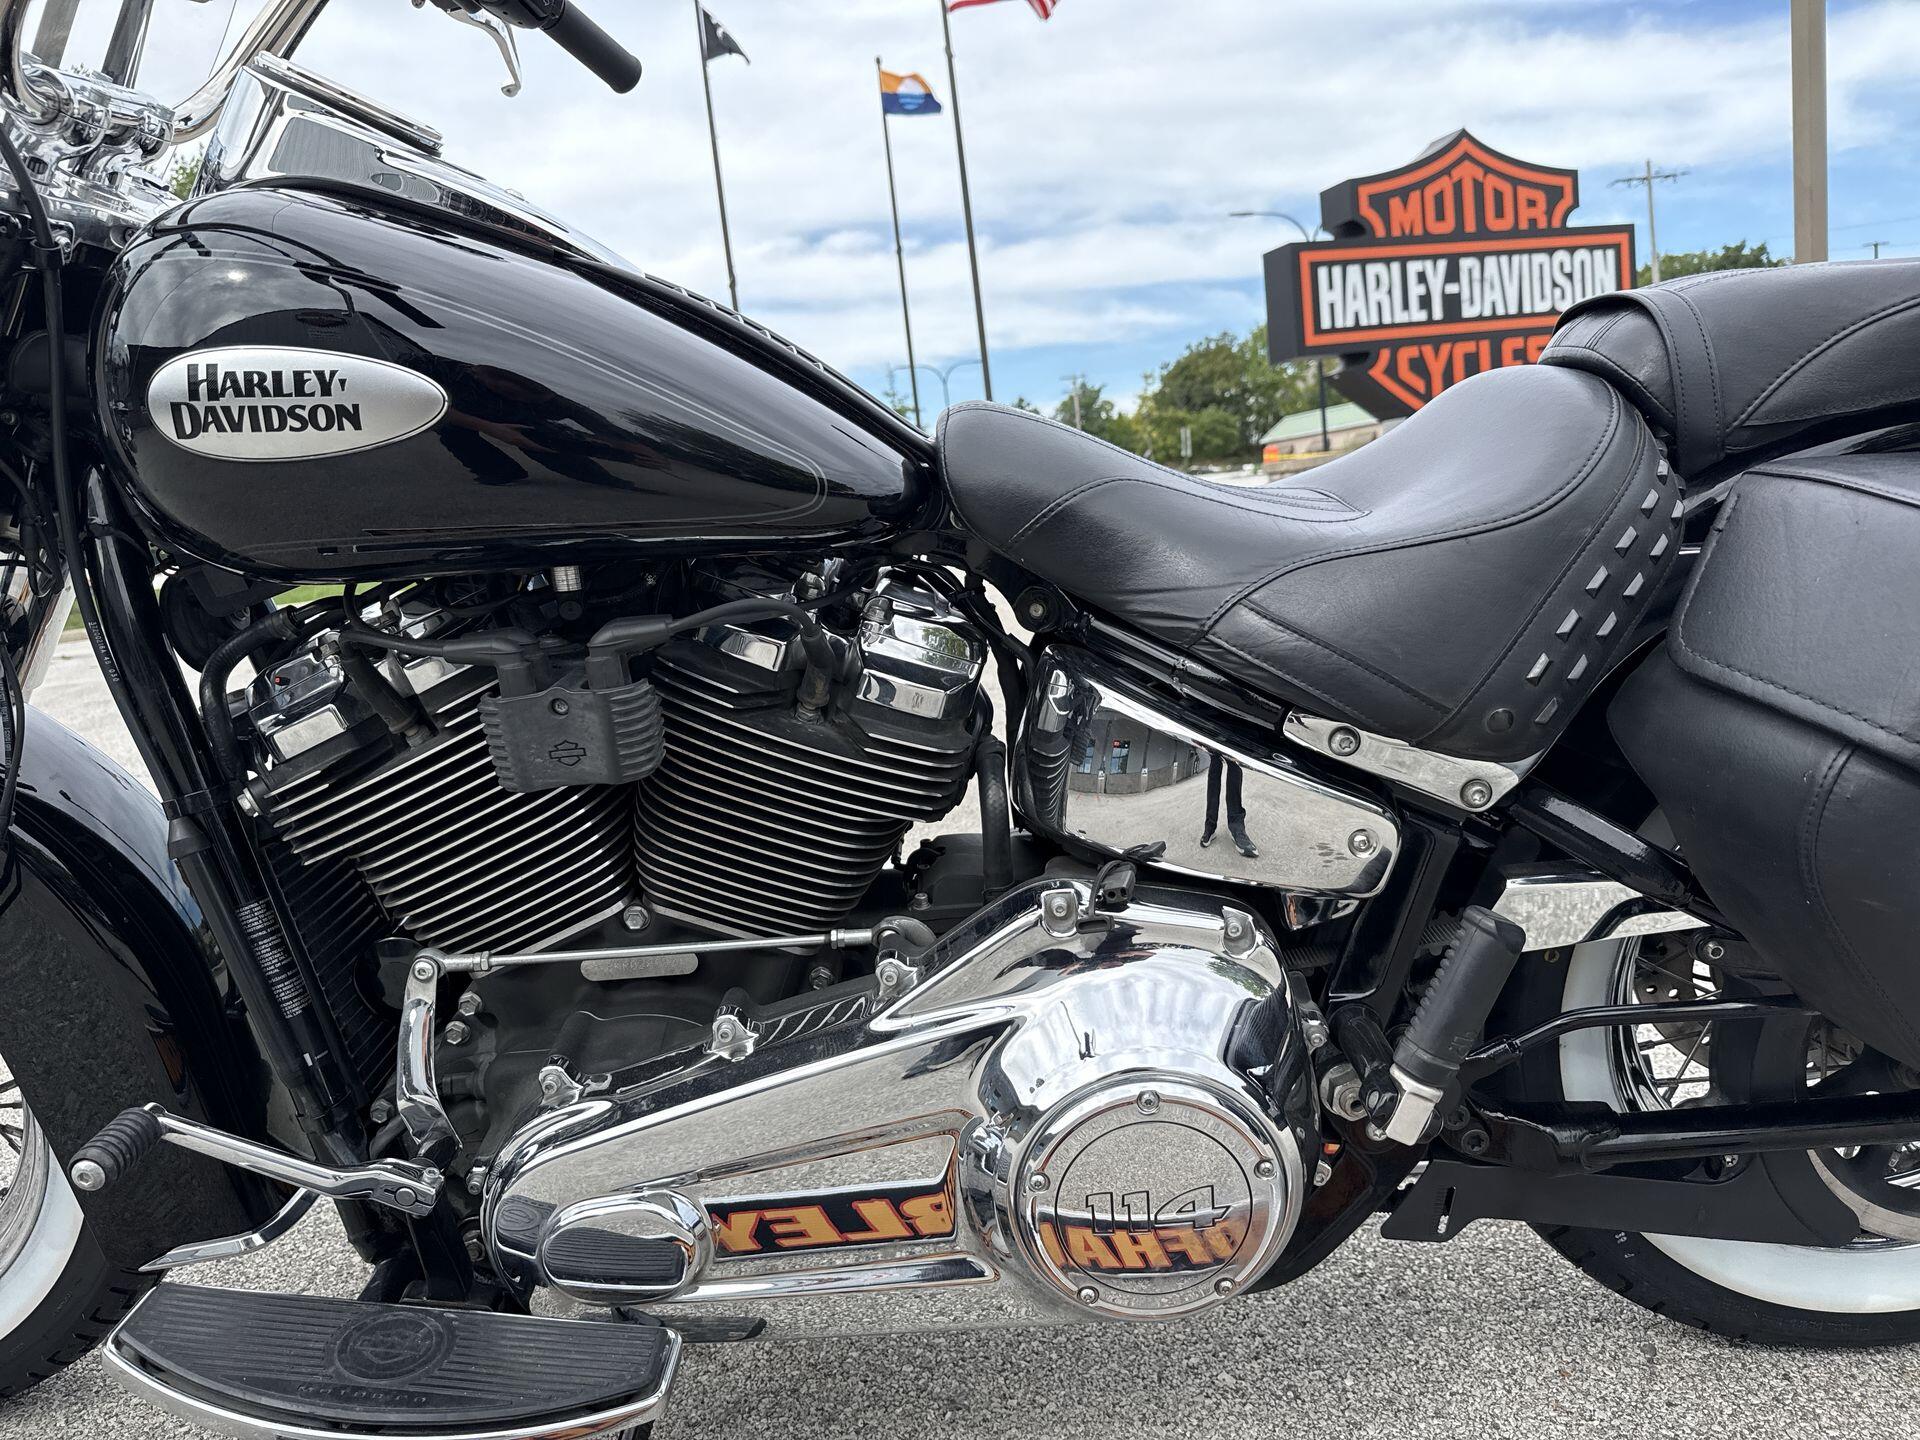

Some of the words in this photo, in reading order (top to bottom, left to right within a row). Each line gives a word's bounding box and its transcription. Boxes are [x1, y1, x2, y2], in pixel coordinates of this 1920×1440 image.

[1388, 160, 1548, 238] MOTOR
[1317, 248, 1617, 330] HARLEY-DAVIDSON
[170, 401, 363, 440] DAVIDSON
[1085, 1184, 1232, 1236] 114
